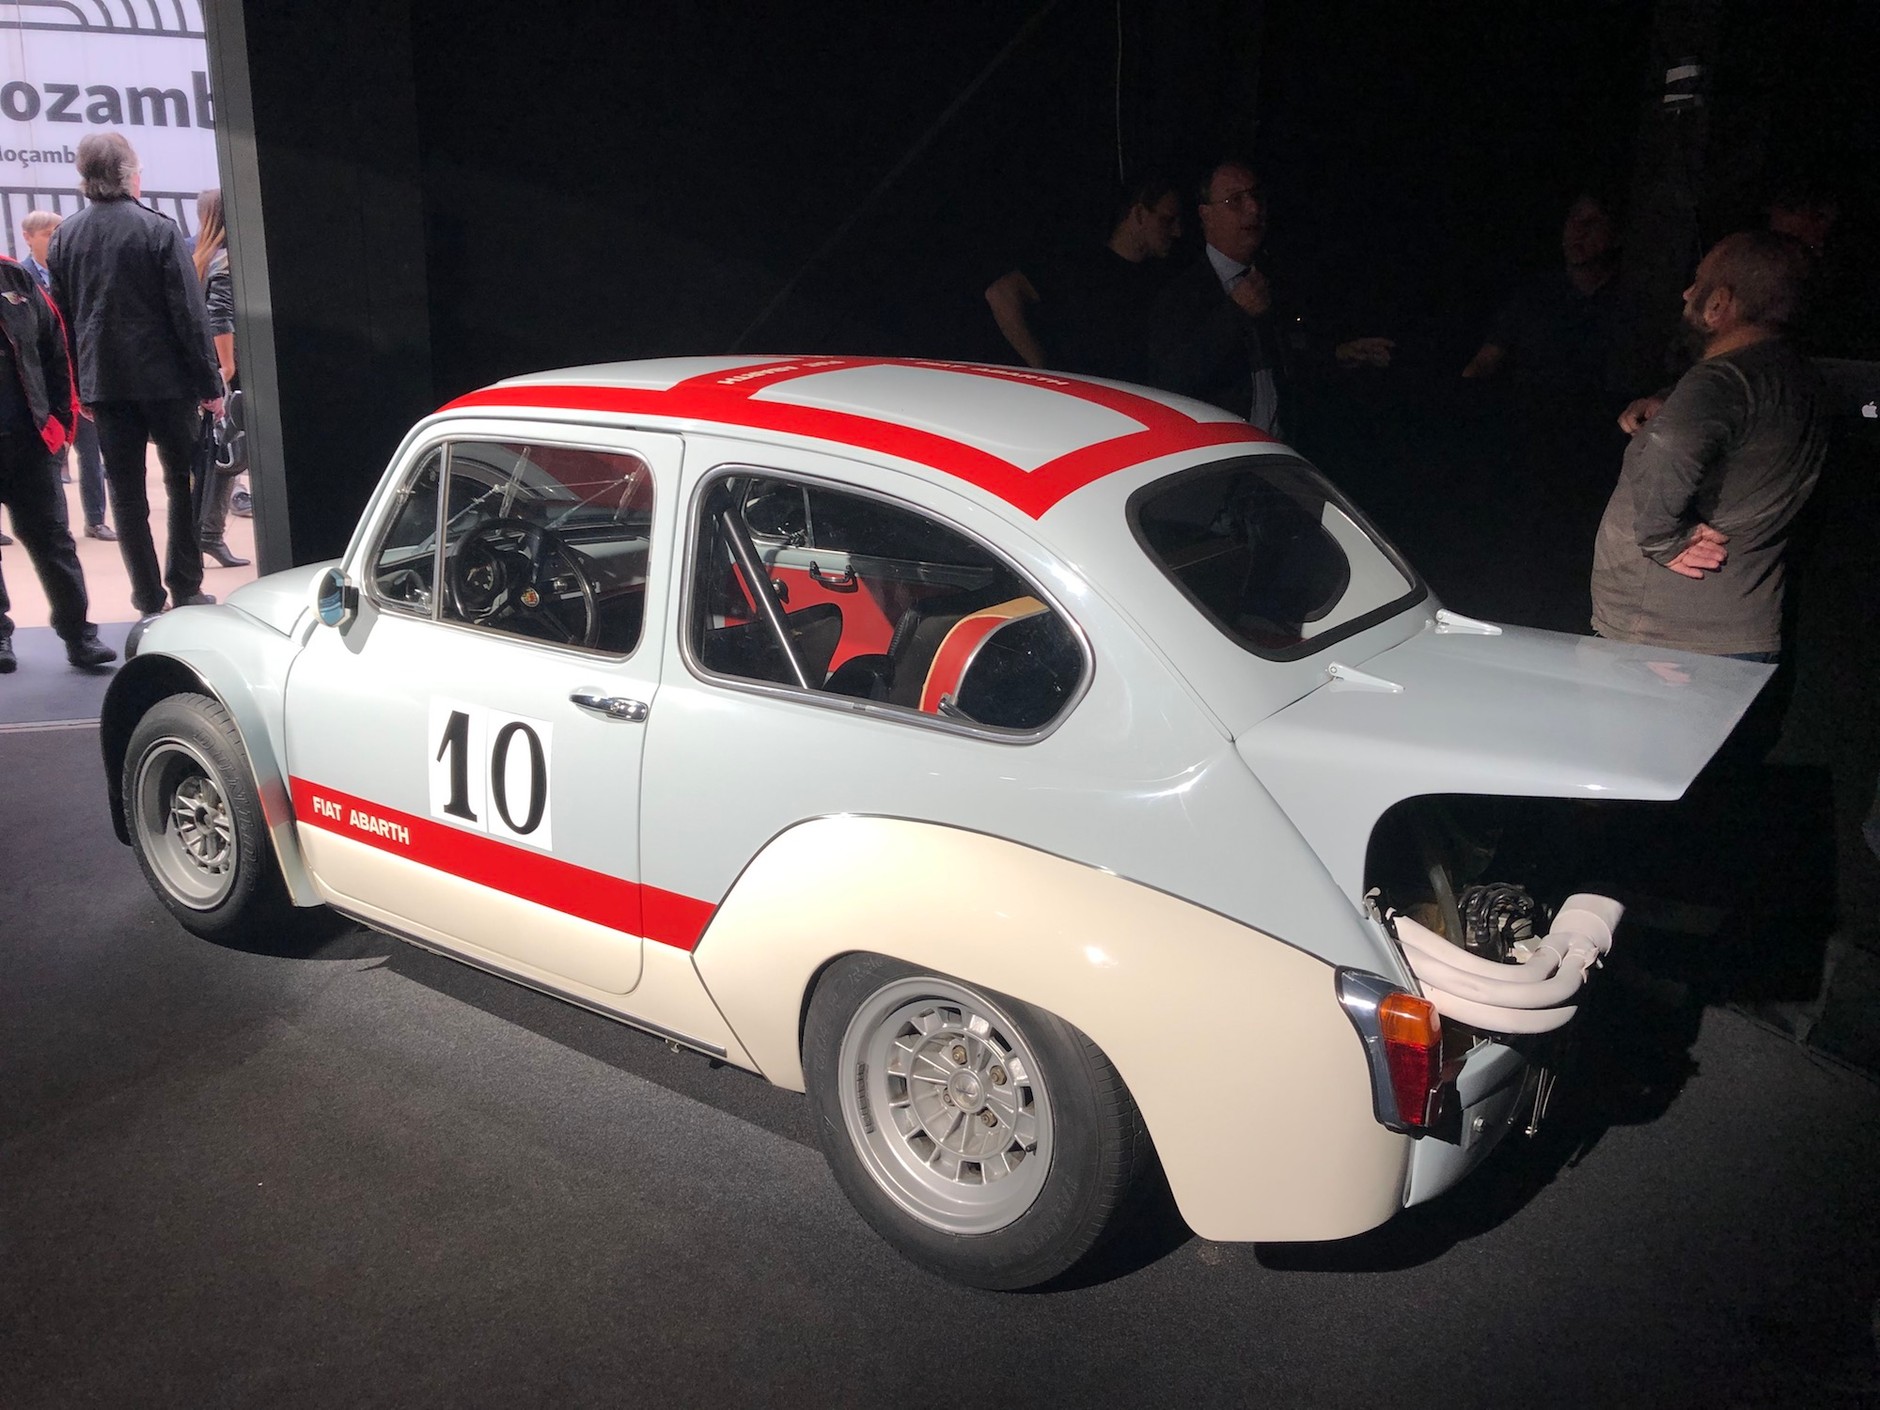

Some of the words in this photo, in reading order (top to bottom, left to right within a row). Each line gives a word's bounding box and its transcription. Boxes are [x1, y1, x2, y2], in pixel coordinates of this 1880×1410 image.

[436, 709, 548, 836] 10
[312, 795, 342, 822] FIAT
[349, 808, 410, 846] ABARTH
